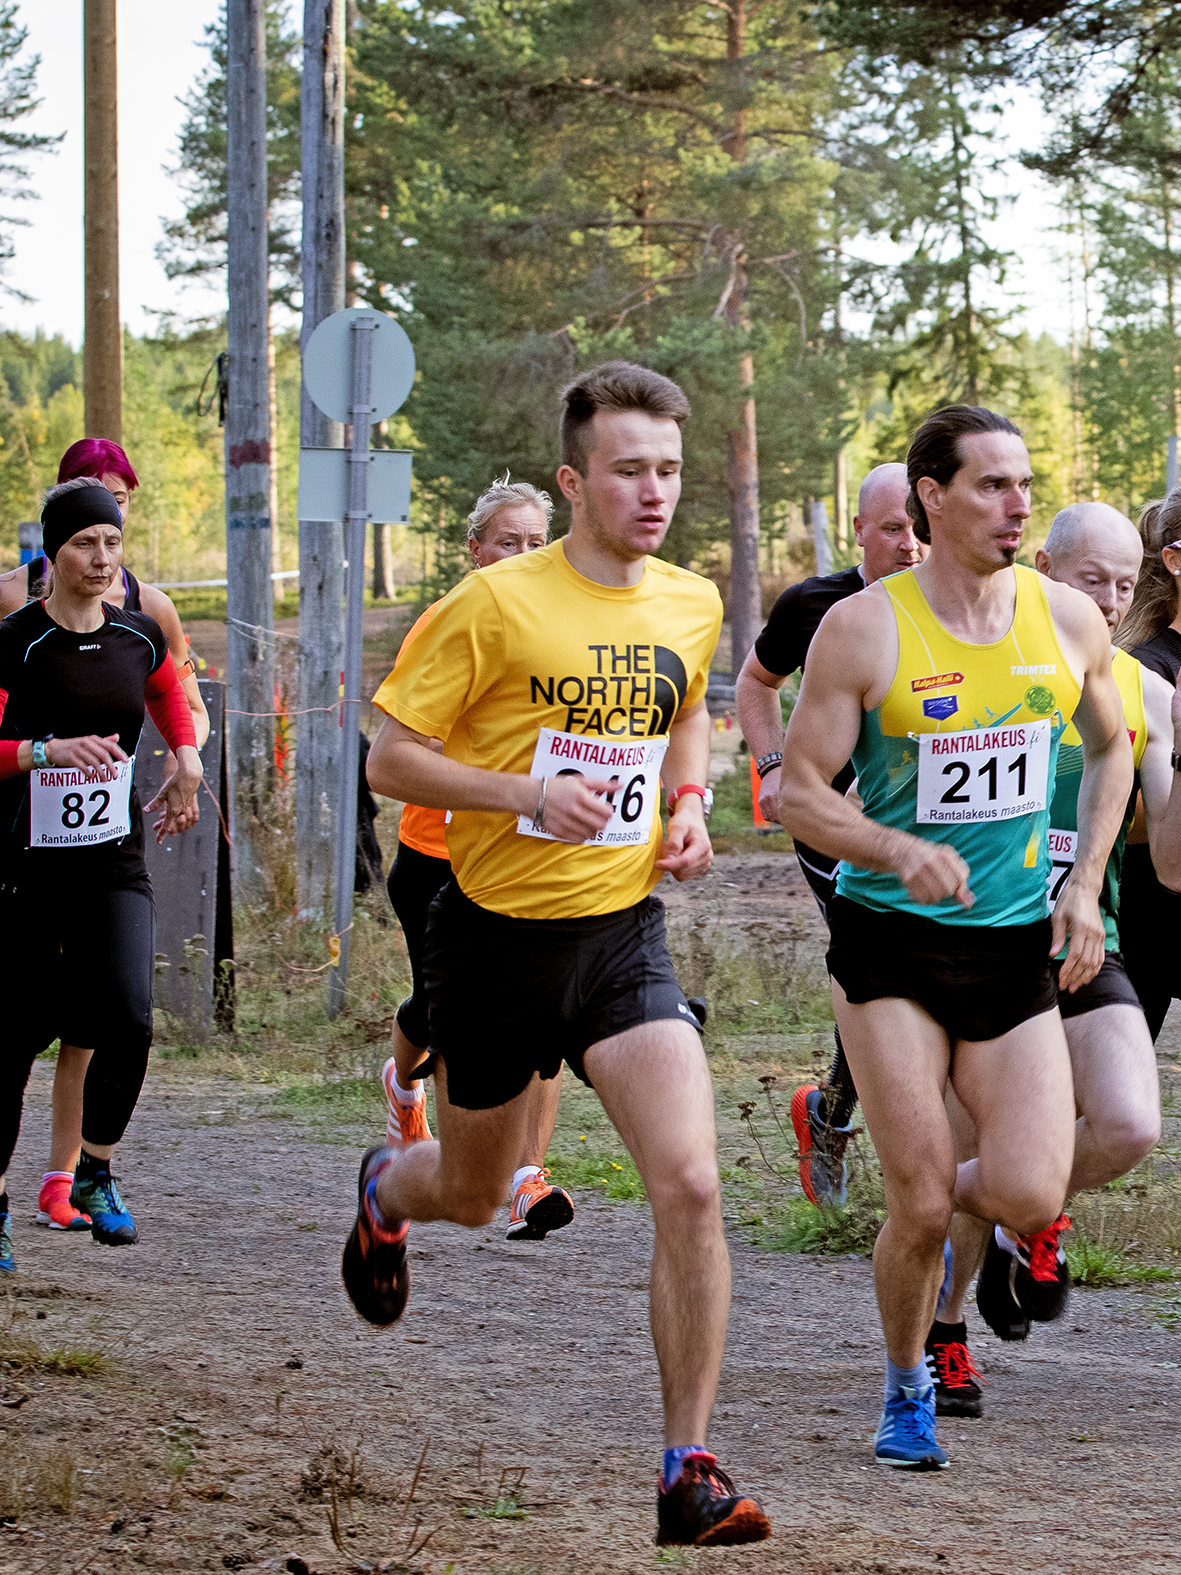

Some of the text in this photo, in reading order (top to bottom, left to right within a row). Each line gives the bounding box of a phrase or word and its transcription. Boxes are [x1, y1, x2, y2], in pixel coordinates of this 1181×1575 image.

[588, 645, 650, 674] THE
[1010, 664, 1057, 676] TRIMTEX
[530, 676, 651, 706] NORTH
[564, 707, 649, 736] FACE
[940, 752, 1027, 804] 211
[61, 789, 111, 829] 82
[929, 800, 1035, 821] Rantalakeus maasto
[41, 825, 123, 844] Rantalakeus maasto
[606, 831, 642, 842] maasto
